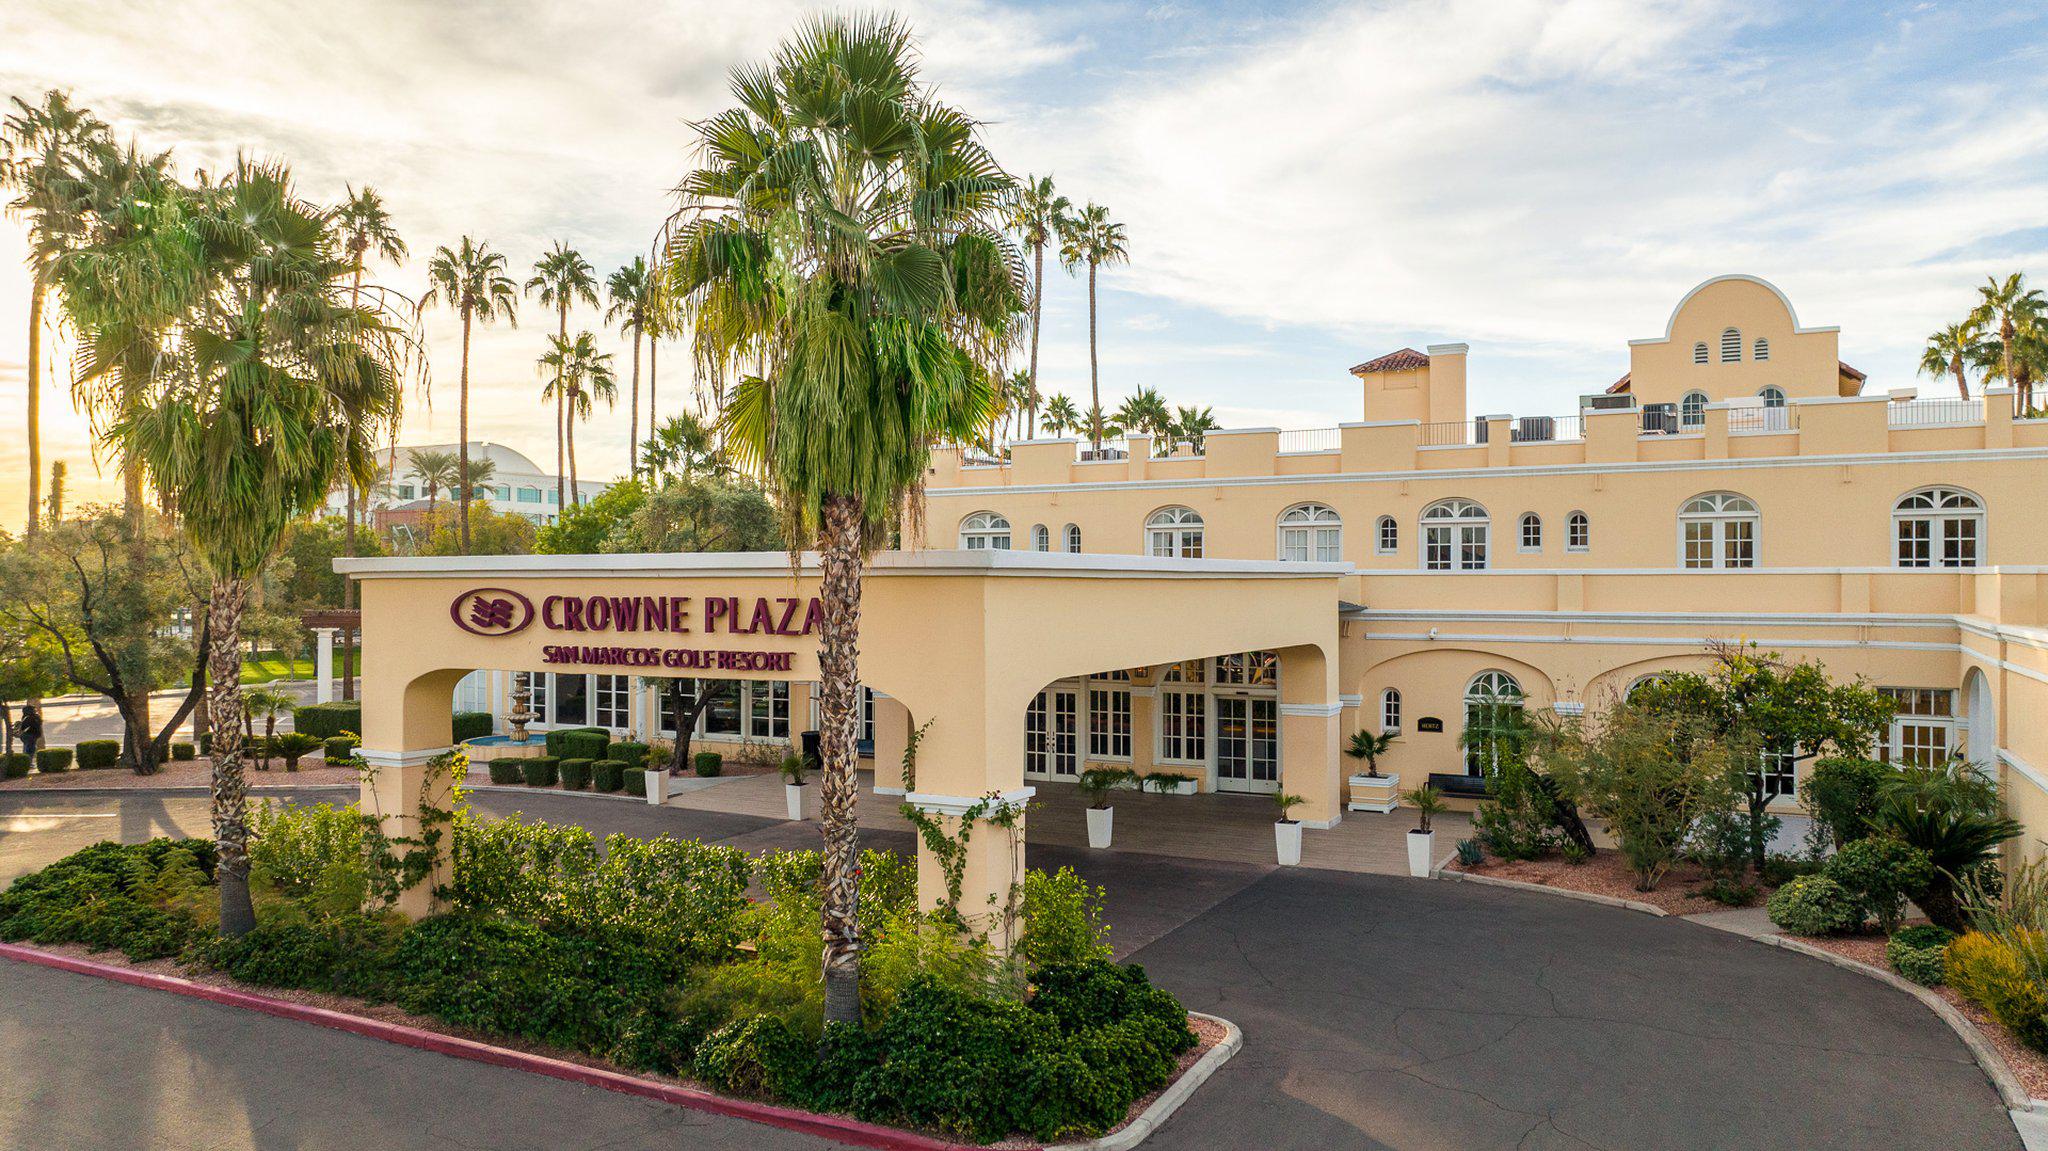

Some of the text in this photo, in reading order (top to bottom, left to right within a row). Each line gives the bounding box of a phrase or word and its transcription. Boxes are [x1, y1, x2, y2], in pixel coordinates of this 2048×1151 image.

[542, 596, 824, 636] CROWNE PLAZA
[542, 645, 797, 672] SAN MARCOS GOLF RESORT
